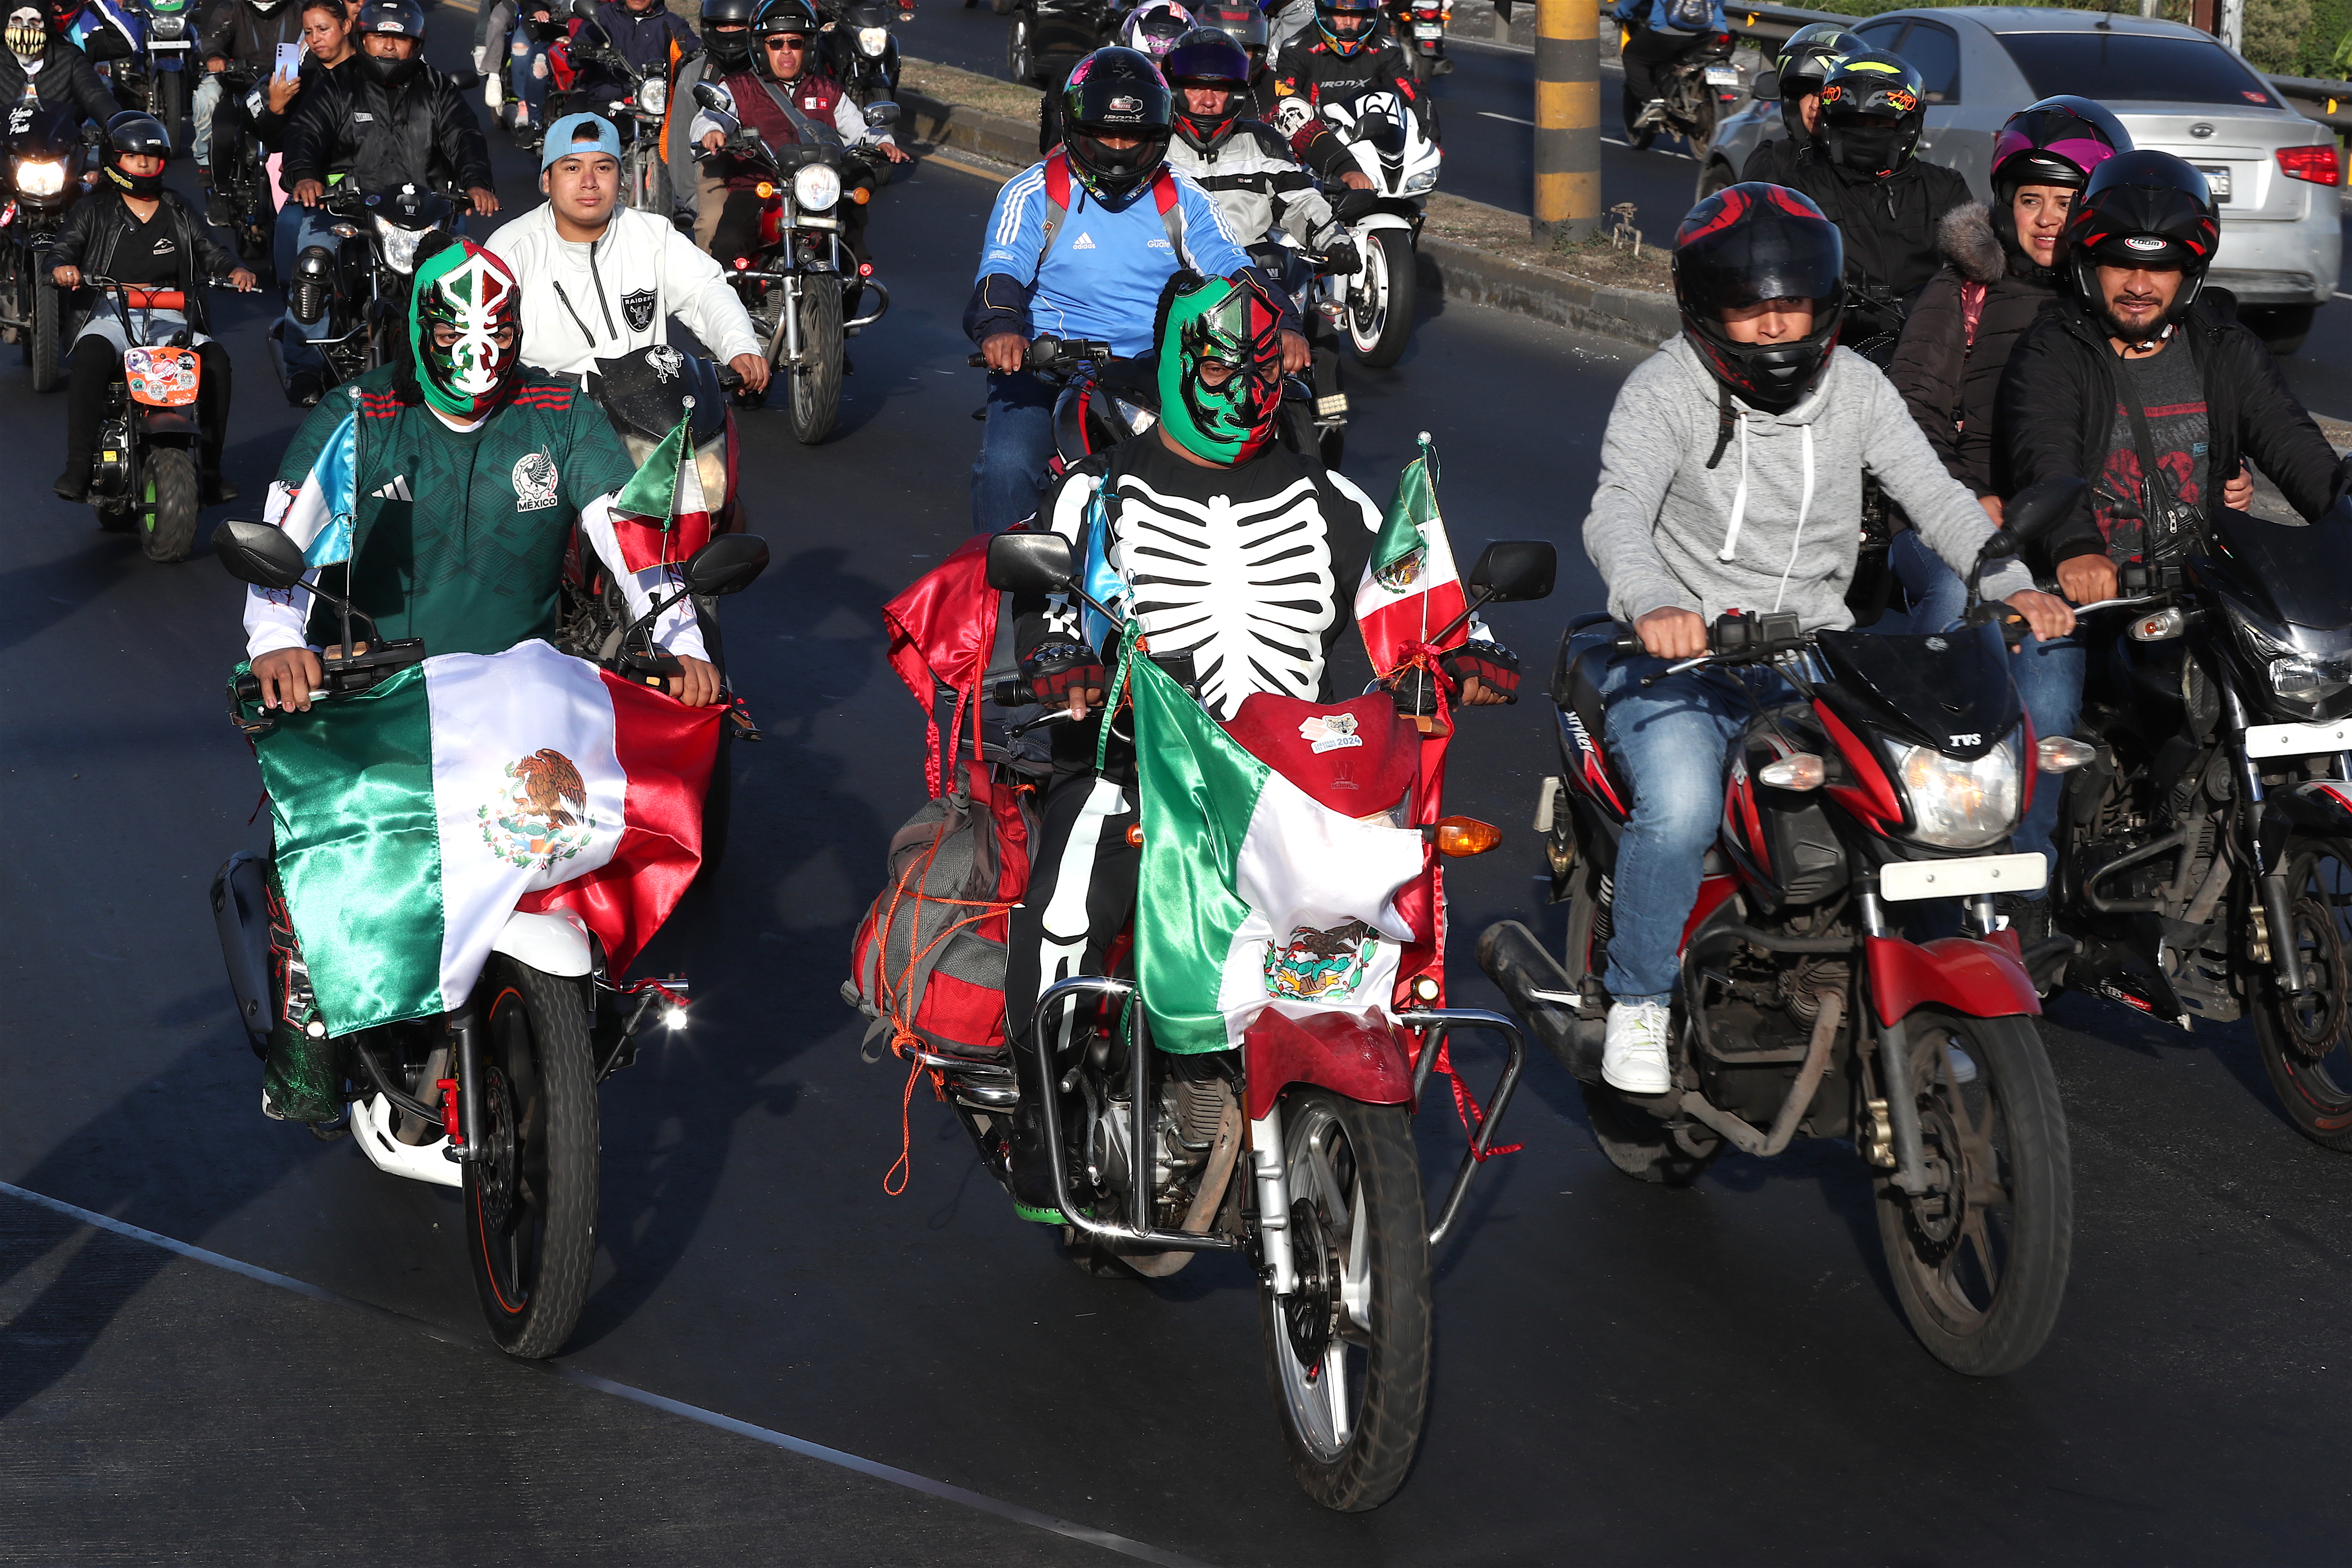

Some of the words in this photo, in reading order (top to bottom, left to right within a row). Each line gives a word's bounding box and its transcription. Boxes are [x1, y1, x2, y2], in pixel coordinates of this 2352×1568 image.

[625, 294, 654, 305] RAIDERS
[163, 363, 175, 374] LIQUI
[166, 367, 178, 377] MOLY
[518, 498, 556, 511] MÉXICO
[1314, 740, 1335, 748] CARAVANA
[1337, 737, 1360, 746] 2024
[1949, 733, 1981, 747] TVS
